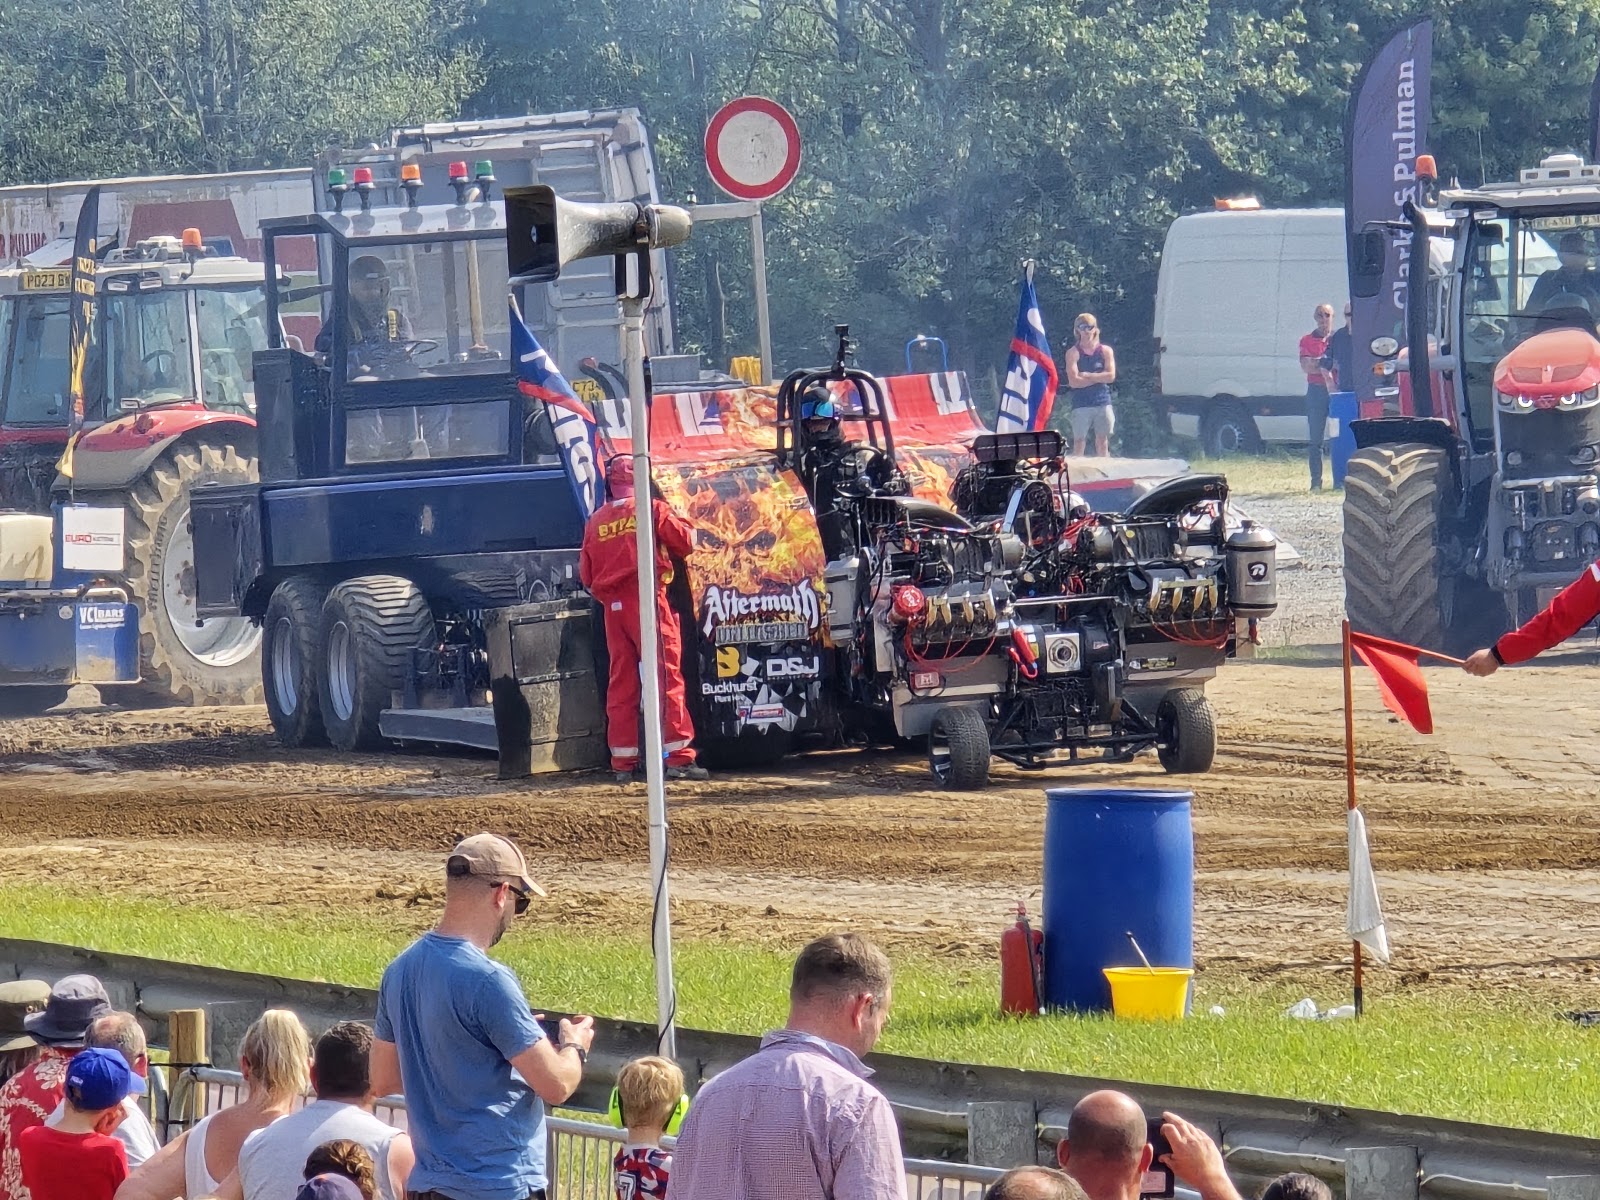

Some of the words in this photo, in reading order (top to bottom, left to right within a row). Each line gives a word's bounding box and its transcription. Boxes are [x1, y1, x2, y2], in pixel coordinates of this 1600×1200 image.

[1392, 59, 1416, 182] Pulman
[702, 579, 820, 638] Aftermath
[702, 680, 758, 695] Buckhurst
